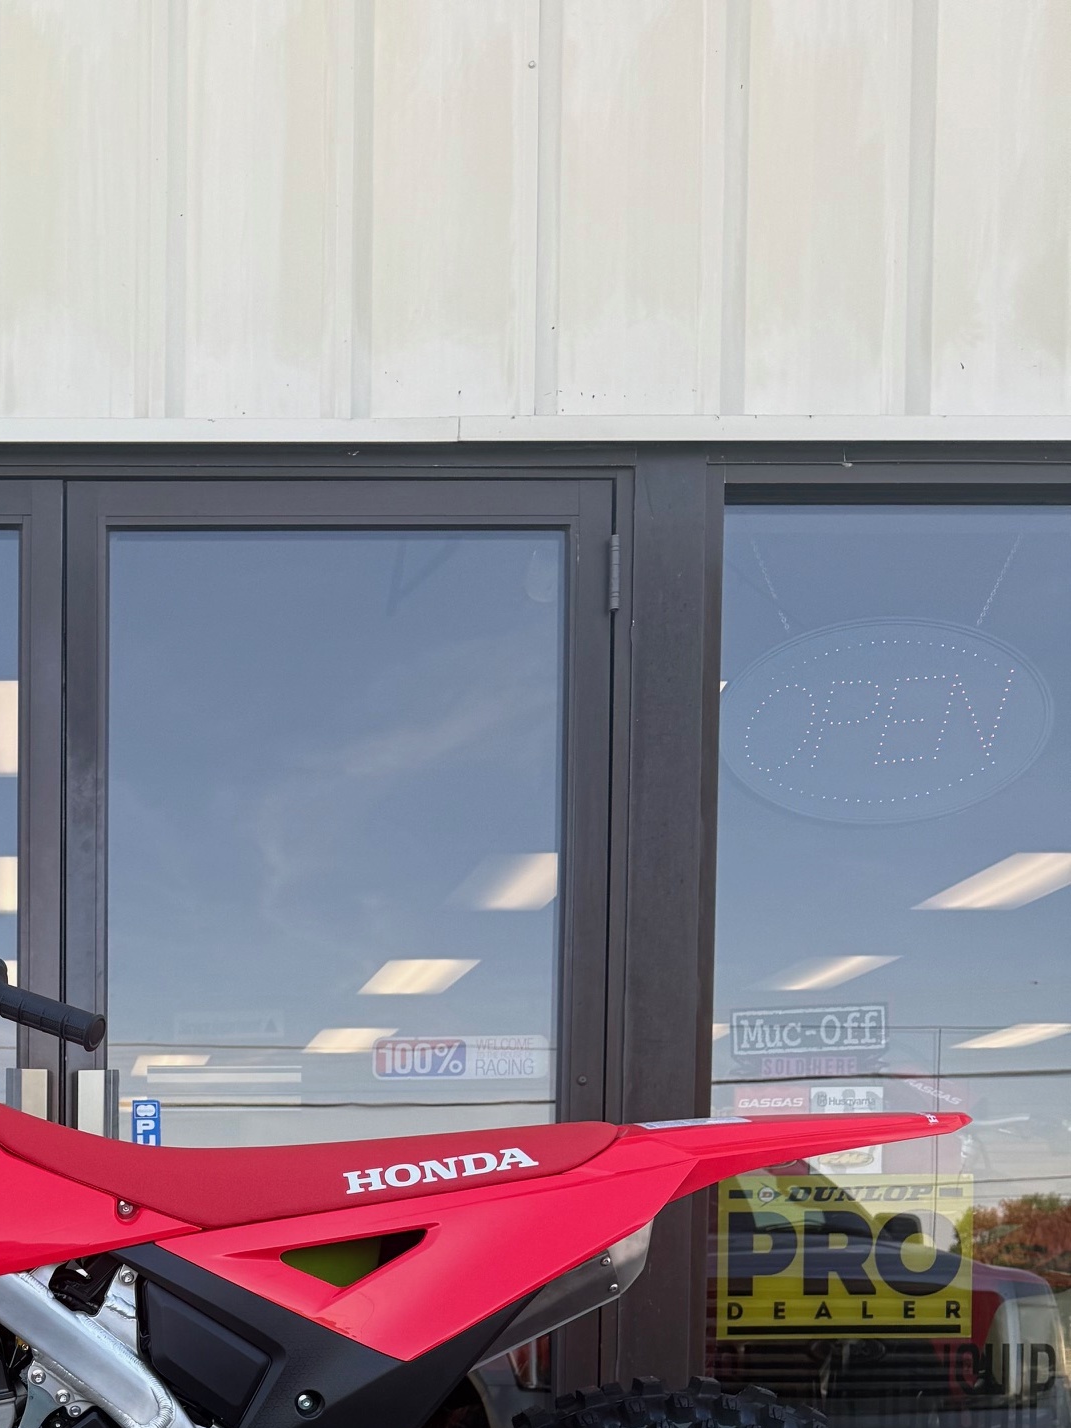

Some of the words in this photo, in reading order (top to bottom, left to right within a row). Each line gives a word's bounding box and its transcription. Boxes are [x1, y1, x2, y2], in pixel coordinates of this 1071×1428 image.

[745, 674, 1015, 772] OPEN
[740, 1010, 878, 1049] Muc-Off
[476, 1037, 534, 1050] WELCOME
[379, 1042, 463, 1075] 100%
[475, 1058, 534, 1076] RACING
[762, 1058, 805, 1076] SOLD
[811, 1057, 856, 1075] HERE
[738, 1097, 804, 1108] GASGAS
[829, 1097, 875, 1107] Husqvarna
[343, 1147, 539, 1195] HONDA
[785, 1185, 934, 1202] DUNLOP
[727, 1209, 962, 1297] PRO
[727, 1301, 961, 1321] DEALER
